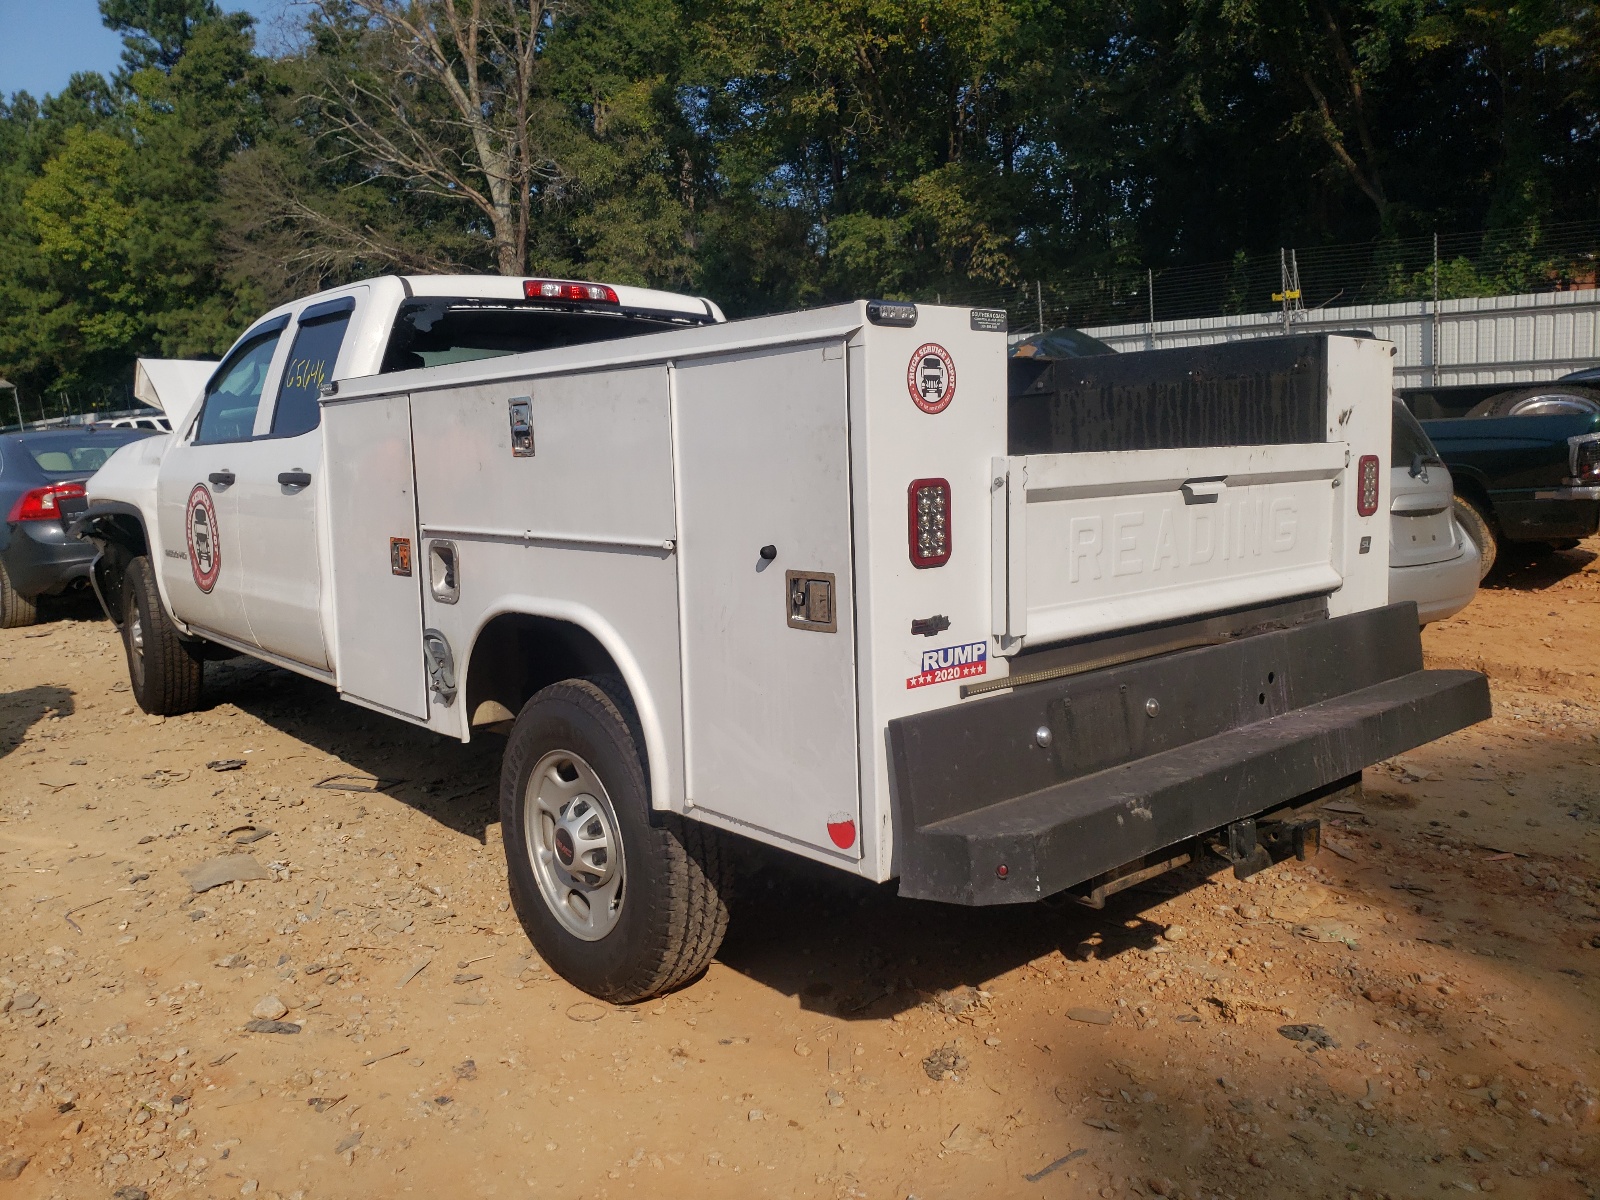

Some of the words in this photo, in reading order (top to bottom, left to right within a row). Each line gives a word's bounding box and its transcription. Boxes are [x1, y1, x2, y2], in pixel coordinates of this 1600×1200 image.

[909, 354, 920, 387] TRUCK
[918, 345, 947, 358] SERVICE
[945, 359, 955, 388] DEPOT
[1069, 497, 1298, 584] READING
[923, 643, 986, 672] RUMP
[934, 667, 961, 683] 2020
